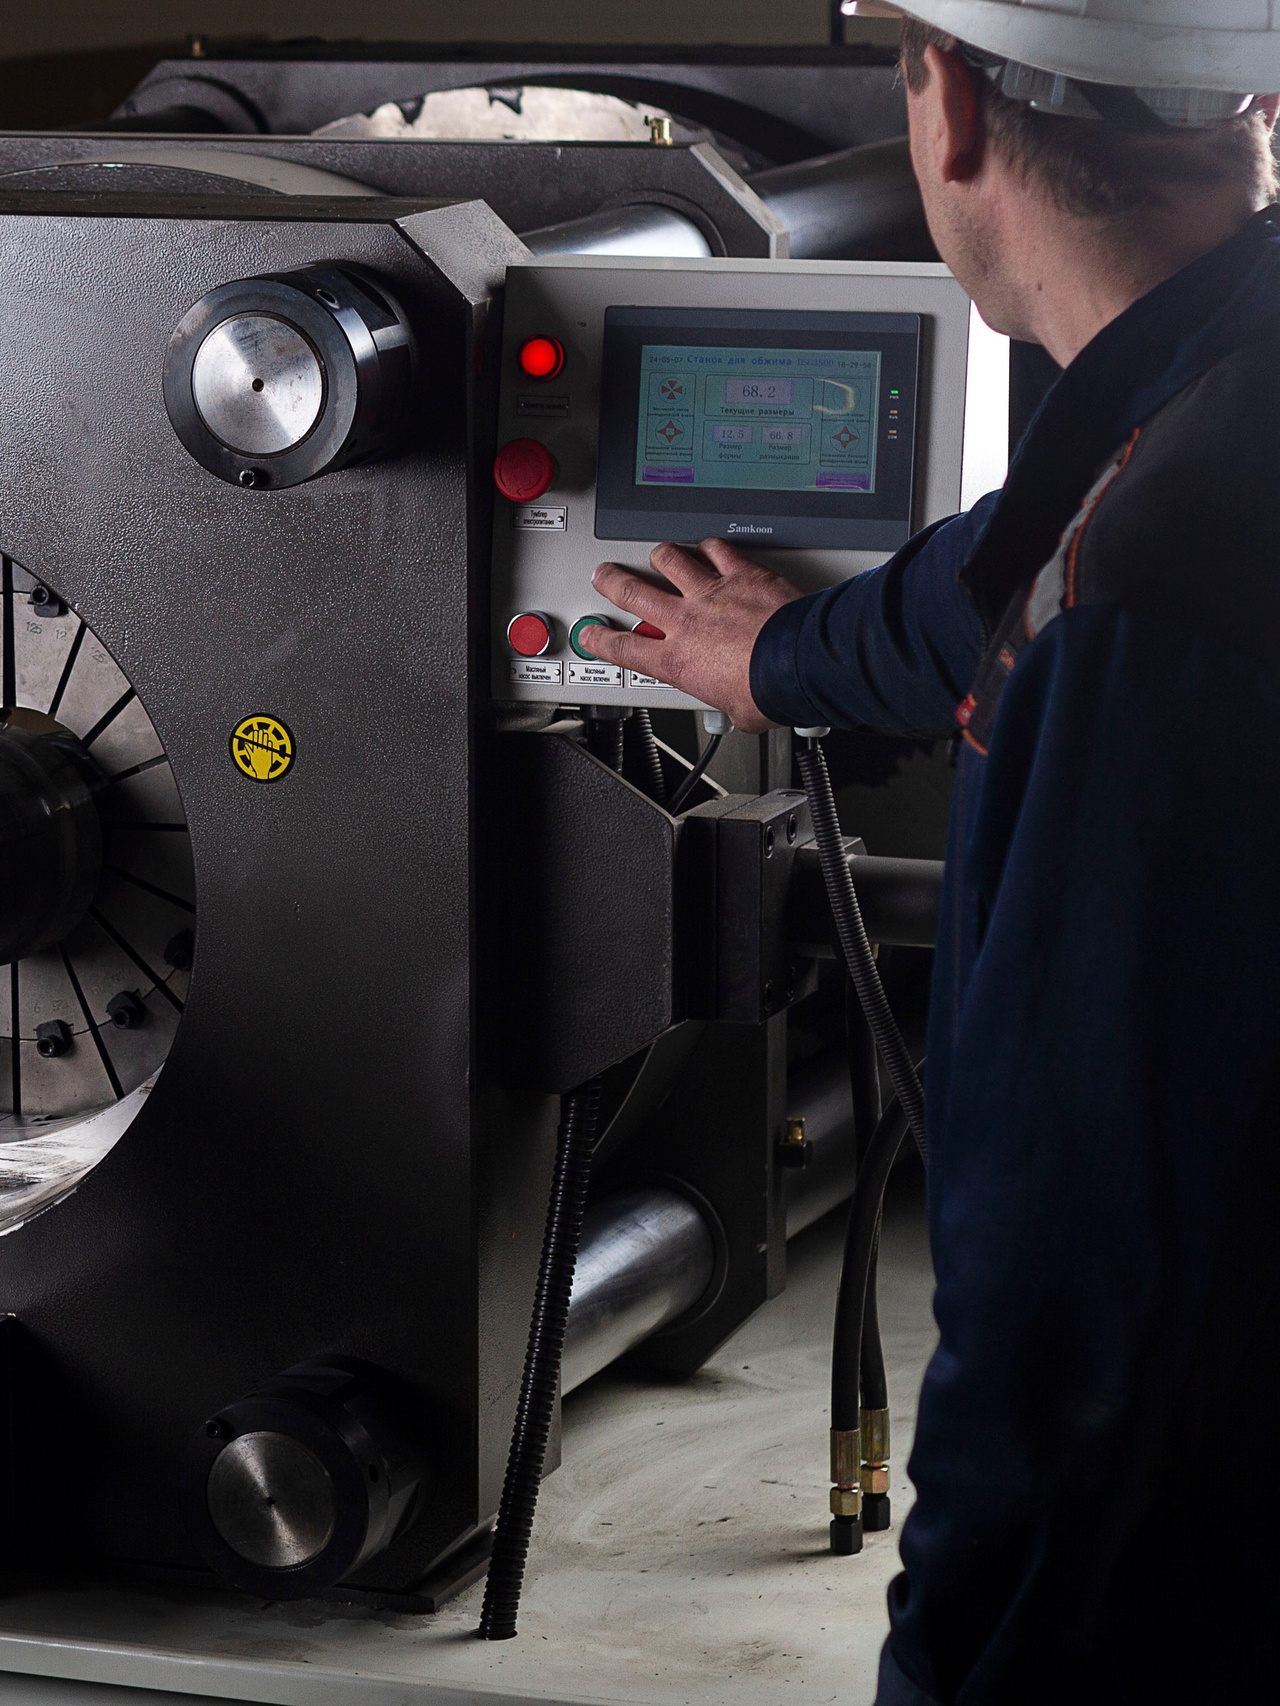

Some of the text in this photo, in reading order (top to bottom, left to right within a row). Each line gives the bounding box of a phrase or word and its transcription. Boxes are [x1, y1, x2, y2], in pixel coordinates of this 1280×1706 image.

[686, 354, 723, 364] Станок
[727, 358, 746, 366] для
[751, 355, 792, 366] обжима
[741, 385, 776, 399] 68.2
[720, 406, 795, 416] Текущие размеры
[721, 430, 745, 439] 12.5
[718, 443, 743, 451] Размер
[768, 444, 793, 452] Размер
[727, 523, 773, 534] Samkoon
[525, 665, 547, 673] Масляный
[584, 667, 606, 675] Масляный
